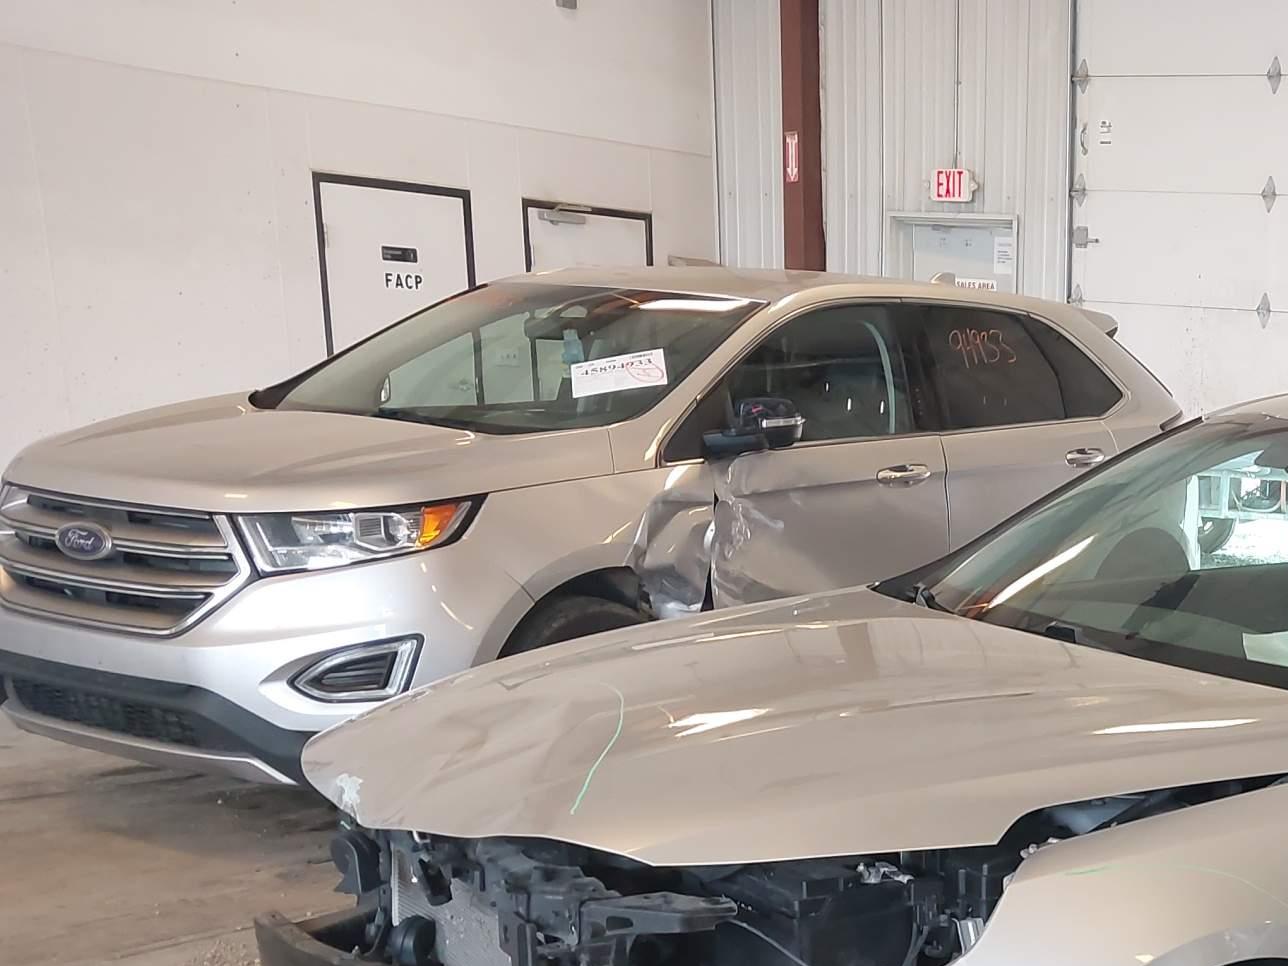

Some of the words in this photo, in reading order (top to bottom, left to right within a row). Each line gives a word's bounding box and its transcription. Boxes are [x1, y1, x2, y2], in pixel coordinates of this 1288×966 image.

[937, 170, 963, 198] EXIT
[385, 272, 422, 290] FACP
[65, 529, 95, 550] Ford
